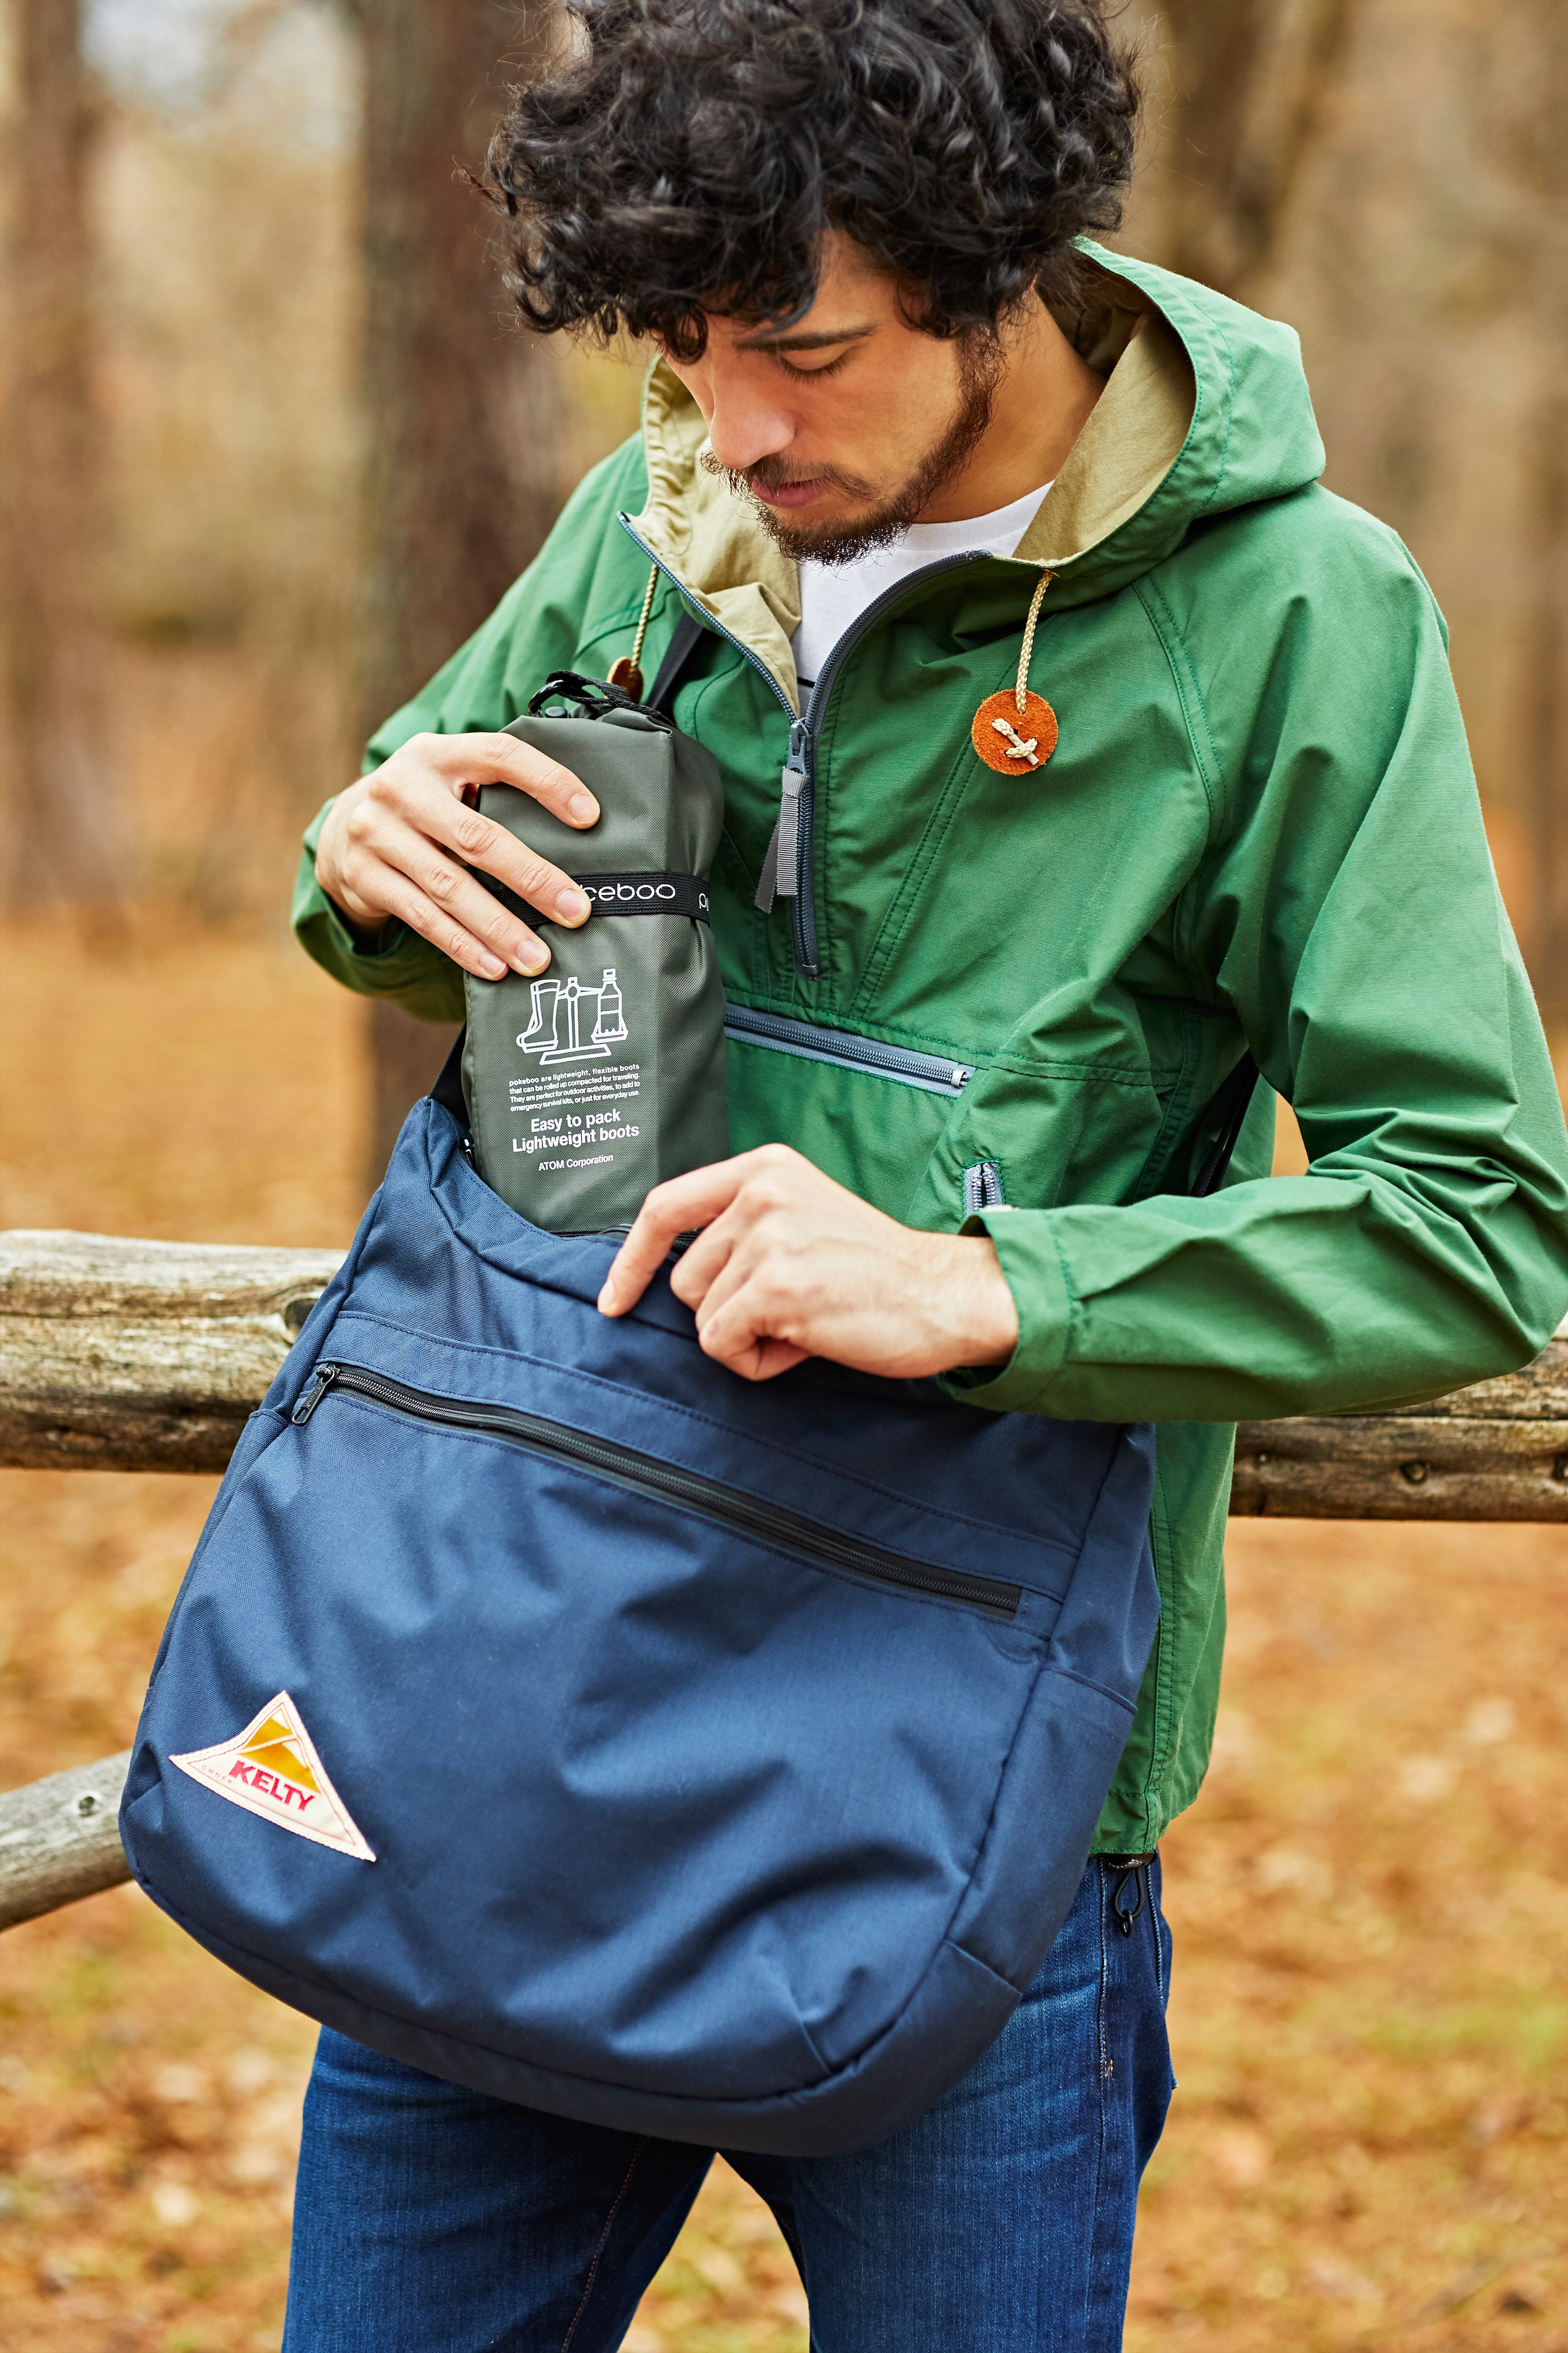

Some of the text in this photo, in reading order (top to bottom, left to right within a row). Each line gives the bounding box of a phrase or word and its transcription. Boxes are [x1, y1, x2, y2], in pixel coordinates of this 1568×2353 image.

[509, 1078, 539, 1087] pokeboo
[592, 1066, 618, 1074] flexible
[568, 1076, 602, 1086] compacted
[510, 1103, 542, 1111] emergency
[542, 1098, 561, 1107] survival
[581, 1095, 592, 1103] just
[602, 1091, 628, 1100] everyday
[535, 1091, 554, 1101] perfect
[531, 1108, 621, 1132] Easy to pack
[512, 1124, 640, 1153] Lightweight boots
[538, 1154, 613, 1171] ATOM Corporation
[228, 1760, 315, 1812] KELTY
